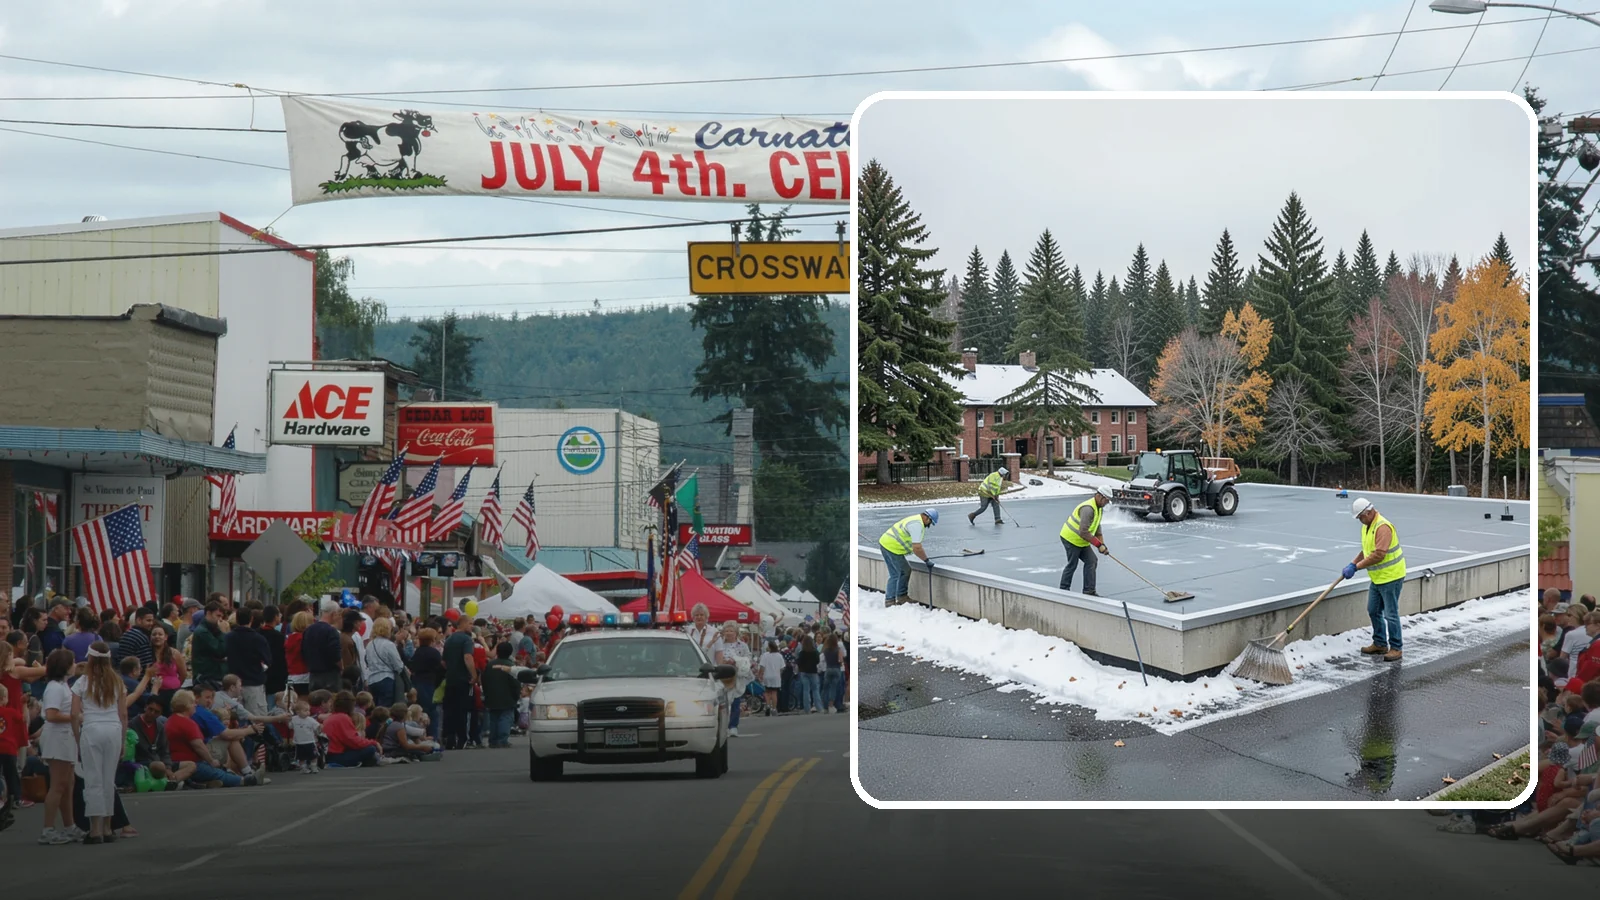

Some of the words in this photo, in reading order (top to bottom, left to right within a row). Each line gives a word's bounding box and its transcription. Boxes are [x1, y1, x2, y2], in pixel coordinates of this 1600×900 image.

[481, 141, 605, 192] JULY
[632, 150, 747, 198] 4th.
[697, 254, 850, 280] CROSSWA
[283, 380, 373, 420] ACE
[406, 409, 452, 421] CEDAR
[283, 421, 371, 437] Hardware
[416, 428, 477, 447] Coca-Cola
[353, 467, 386, 480] Simpl
[83, 485, 93, 494] St.
[96, 485, 124, 494] Vincent
[126, 486, 136, 495] de
[137, 486, 155, 495] Paul
[81, 503, 154, 522] THT
[688, 526, 741, 535] CRNATION
[699, 535, 730, 543] GLASS
